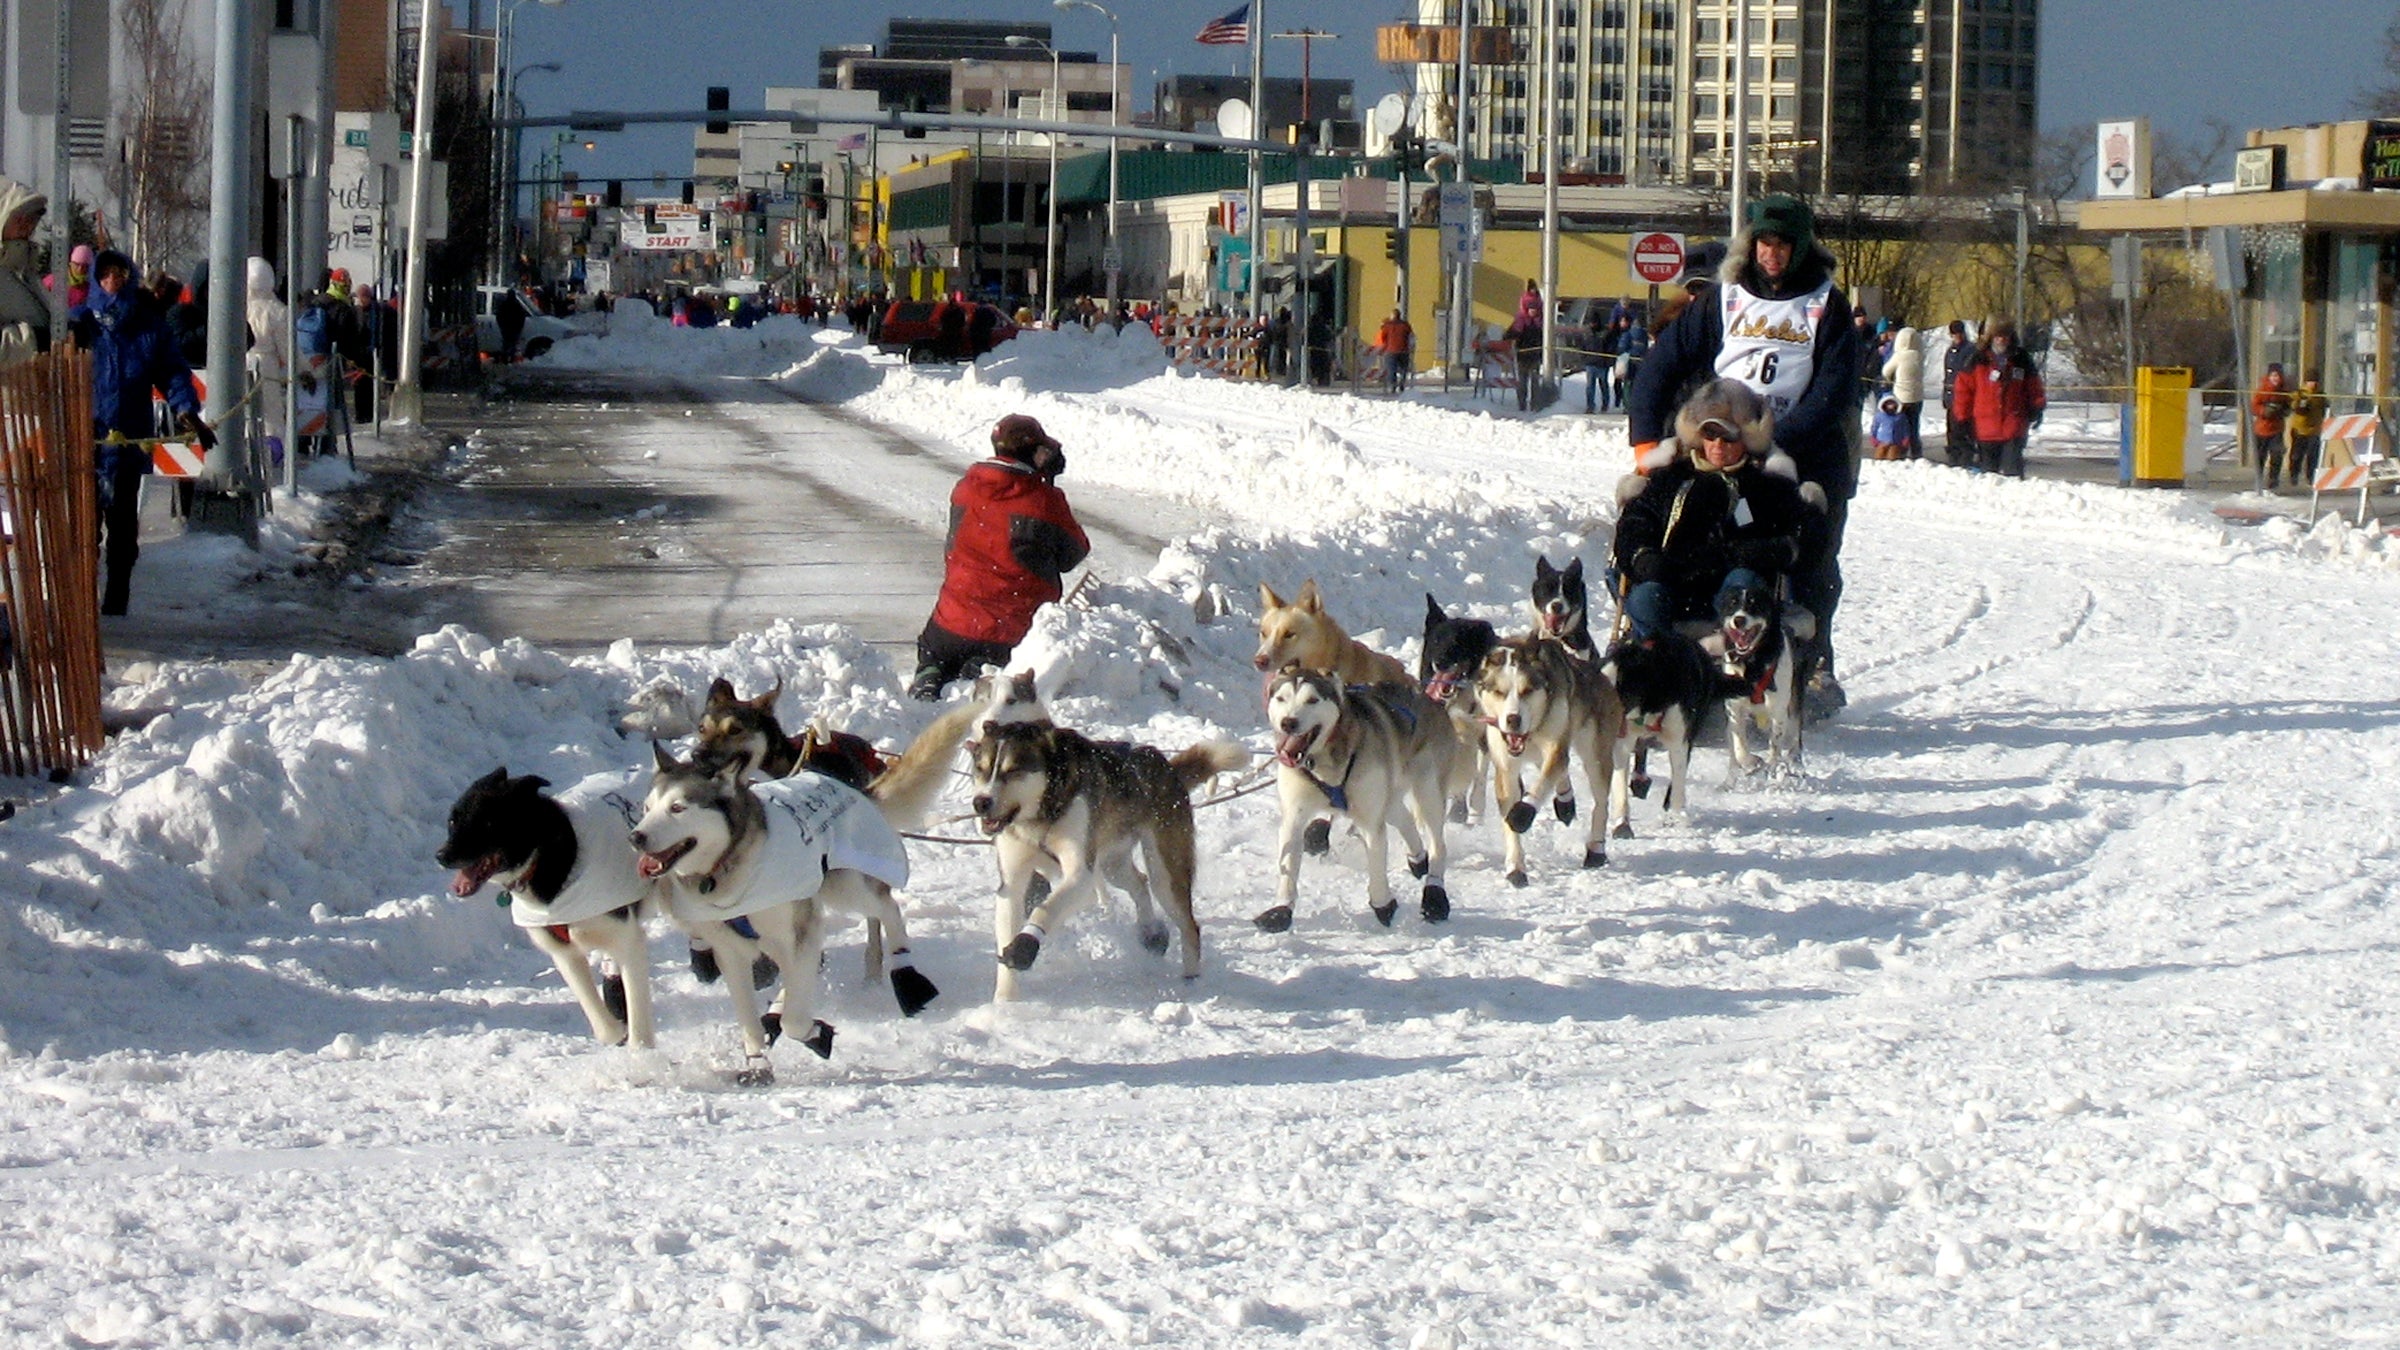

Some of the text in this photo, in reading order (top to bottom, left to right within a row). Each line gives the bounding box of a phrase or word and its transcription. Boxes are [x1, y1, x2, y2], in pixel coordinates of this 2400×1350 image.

[645, 236, 692, 247] START
[1640, 242, 1676, 252] DO NOT
[1643, 264, 1673, 274] ENTER
